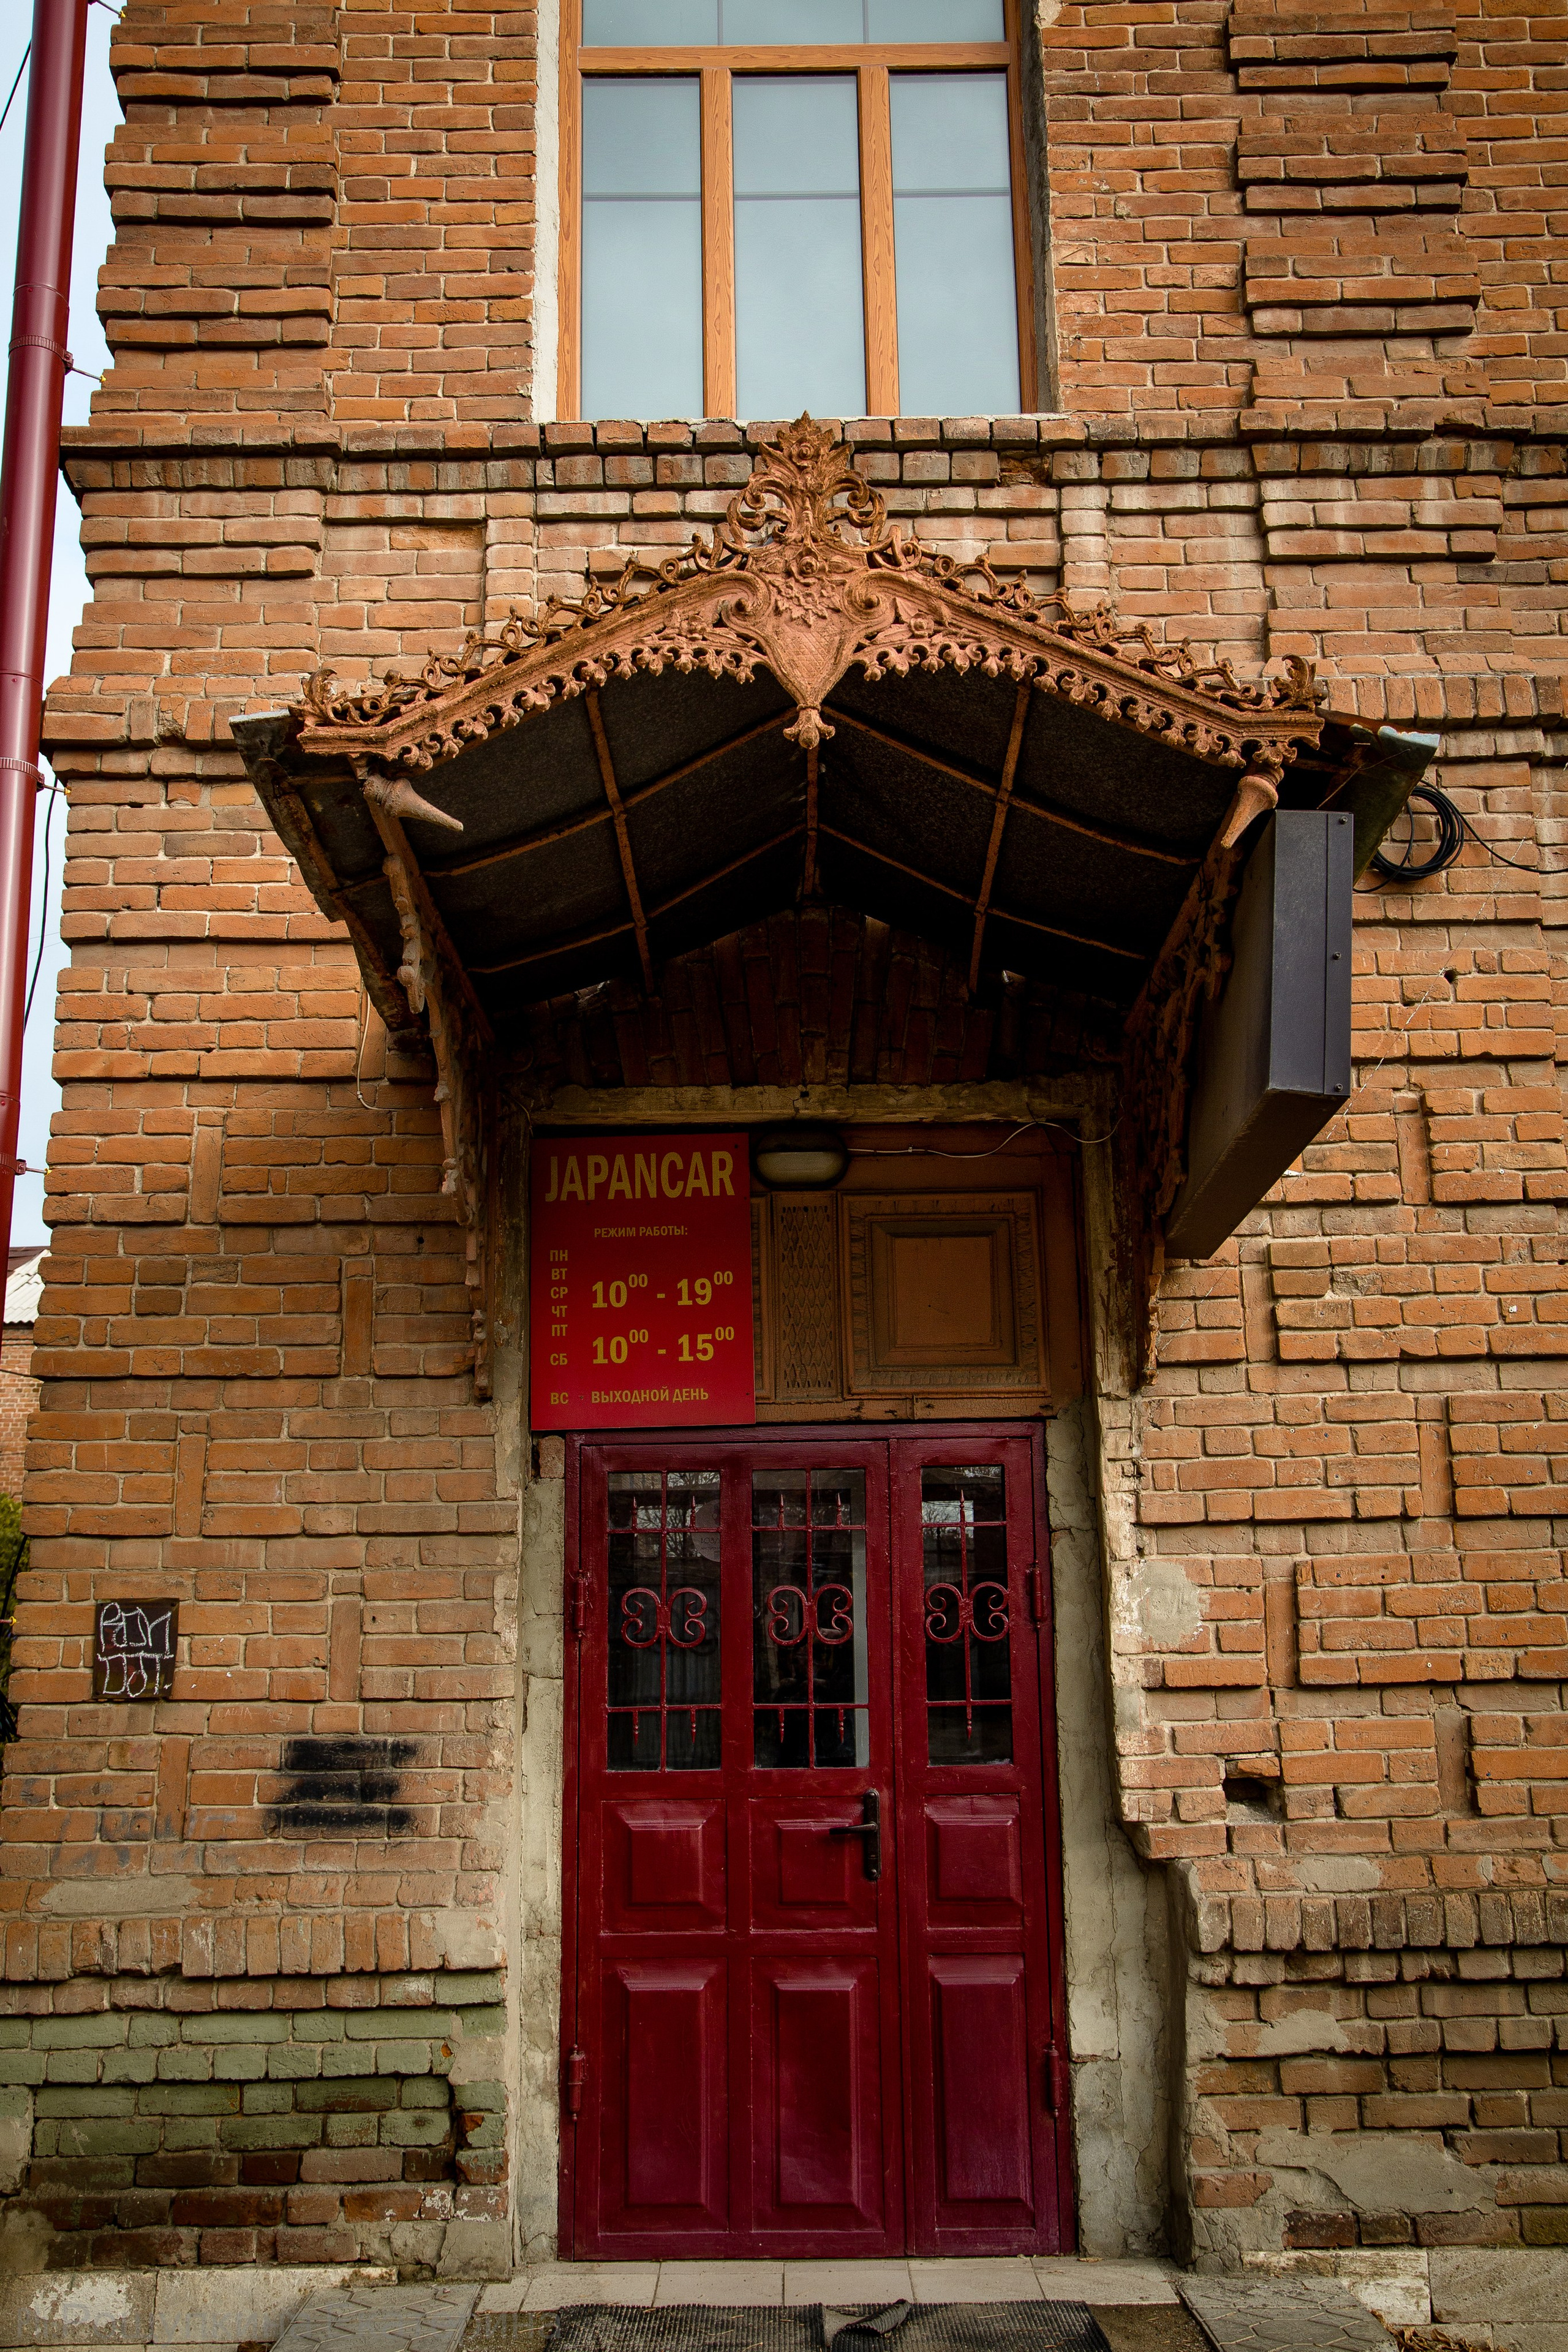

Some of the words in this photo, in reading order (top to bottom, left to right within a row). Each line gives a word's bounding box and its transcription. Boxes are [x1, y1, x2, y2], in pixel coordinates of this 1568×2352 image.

[545, 1151, 735, 1202] JAPANCAR
[594, 1227, 636, 1238] РЕЖИМ
[639, 1225, 688, 1237] РАБОТЫ:
[550, 1250, 568, 1262] ПН
[551, 1268, 568, 1280] ВТ
[550, 1286, 568, 1299] СР
[551, 1305, 568, 1317] ЧТ
[551, 1324, 568, 1336] ПТ
[549, 1353, 568, 1366] СБ
[550, 1392, 569, 1405] ВС
[591, 1385, 669, 1404] ВЫХОДНОЙ
[672, 1387, 709, 1404] ДЕНЬ
